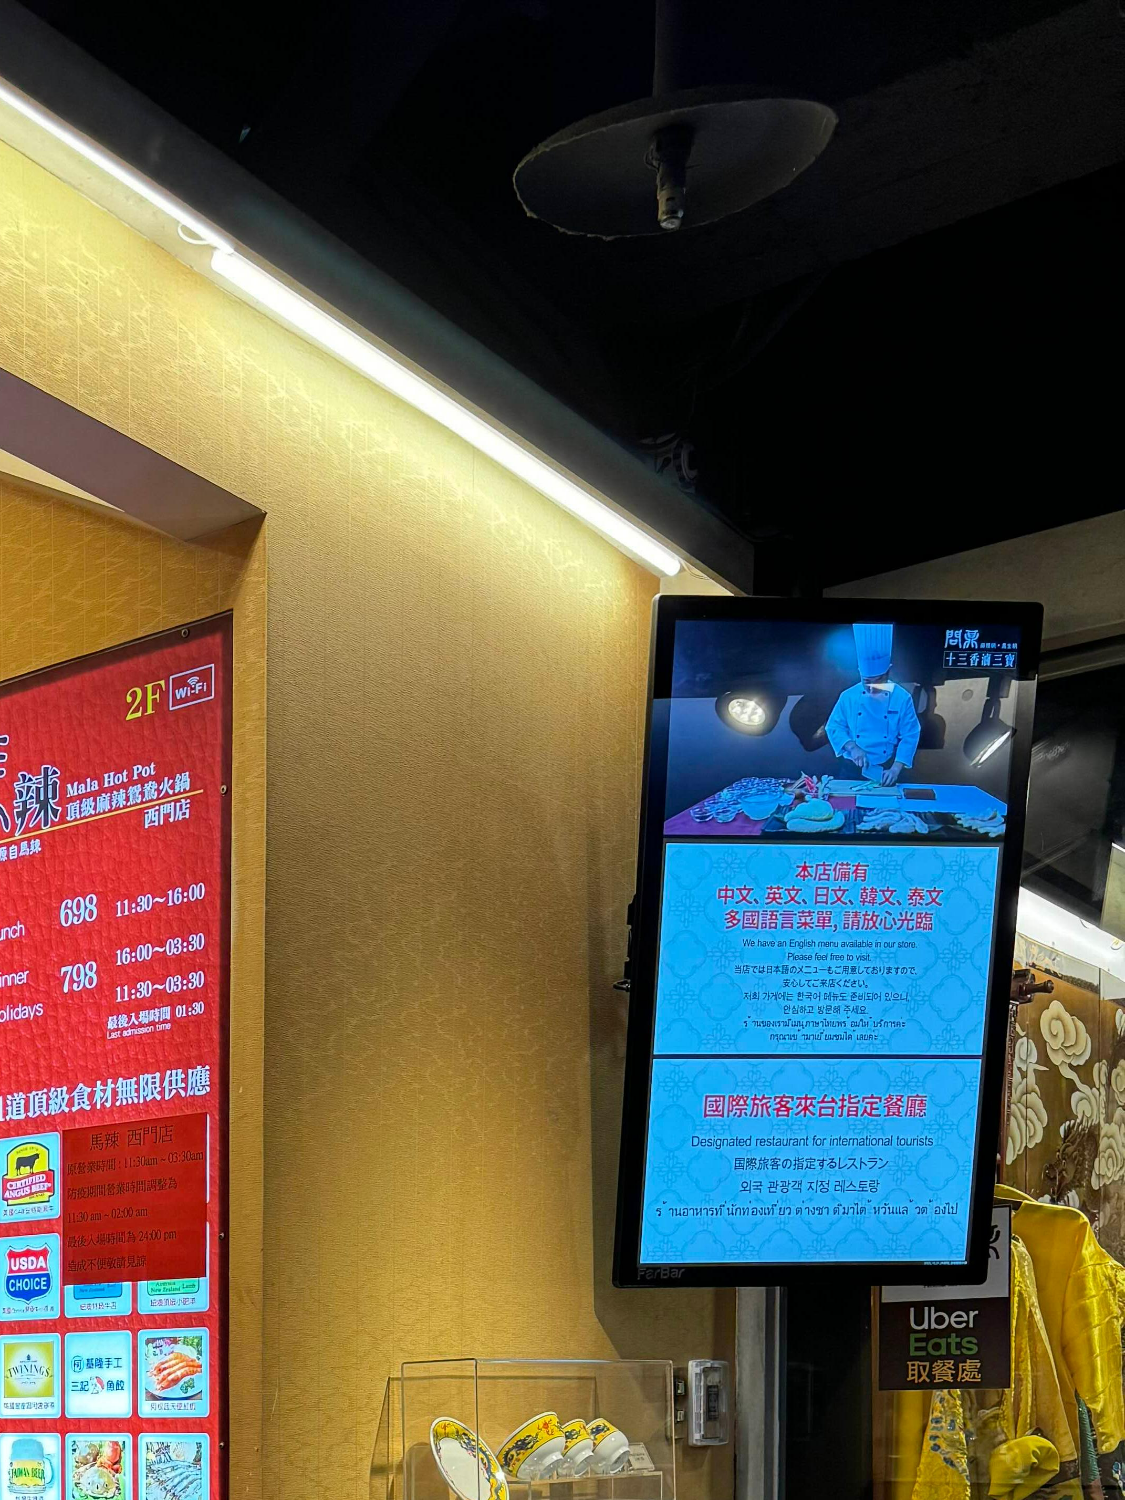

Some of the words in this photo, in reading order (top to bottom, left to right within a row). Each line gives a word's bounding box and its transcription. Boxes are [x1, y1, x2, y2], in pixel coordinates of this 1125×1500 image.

[125, 680, 165, 721] 2F
[174, 682, 207, 701] Wi-Fi
[66, 780, 99, 798] Mala
[104, 770, 129, 788] Hot
[132, 761, 156, 778] Pot
[65, 771, 190, 821] 頂級麻辣鴛鴦火鍋
[143, 799, 191, 829] 西門店
[794, 861, 869, 883] 本店備有
[59, 893, 98, 927] 698
[742, 939, 755, 947] We
[757, 939, 776, 947] have
[789, 939, 816, 950] English
[818, 940, 839, 948] menu
[840, 940, 872, 948] available
[874, 940, 882, 948] in
[883, 941, 896, 949] our
[897, 940, 918, 949] store.
[787, 952, 813, 961] Please
[814, 952, 827, 961] feel
[830, 952, 844, 961] free
[846, 953, 854, 961] to
[855, 952, 872, 961] visit.
[60, 961, 97, 994] 798
[782, 979, 869, 989] 安心してご来店ください。
[743, 991, 760, 1001] 저희
[762, 991, 794, 1001] 가게에는
[797, 991, 821, 1001] 한국어
[823, 991, 848, 1001] 메뉴도
[850, 991, 882, 1002] 준비되어
[106, 1006, 171, 1031] 最後入場時間
[175, 1001, 205, 1020] 01:30
[783, 1005, 814, 1015] 안심하고
[817, 1005, 841, 1015] 방문해
[106, 1028, 122, 1041] Last
[122, 1023, 155, 1037] admission
[156, 1021, 172, 1033] time
[702, 1094, 927, 1119] 國際旅客來台指定餐廳
[89, 1131, 120, 1151] 馬辣
[127, 1124, 174, 1148] 西門店
[690, 1135, 753, 1149] Designated
[755, 1135, 810, 1148] restaurant
[811, 1135, 827, 1148] for
[828, 1135, 894, 1148] international
[895, 1135, 934, 1148] tourists
[733, 1157, 889, 1172] 国際旅客の指定するレストラン
[739, 1179, 763, 1195] 외국
[767, 1179, 803, 1195] 관광객
[806, 1179, 830, 1195] 지정
[834, 1179, 881, 1195] 레스토랑
[67, 1211, 89, 1224] 11:30
[89, 1209, 102, 1221] am
[111, 1206, 134, 1219] 02:00
[135, 1208, 149, 1218] am
[138, 1229, 162, 1242] 24:00
[163, 1230, 177, 1242] pm
[10, 1255, 47, 1272] USDA
[8, 1277, 48, 1292] CHOICE
[909, 1306, 979, 1330] Uber
[909, 1332, 979, 1357] Eats
[6, 1363, 51, 1378] TWININGS
[85, 1357, 123, 1369] 基隆手工
[906, 1359, 983, 1384] 取餐處
[70, 1380, 90, 1392] 三記
